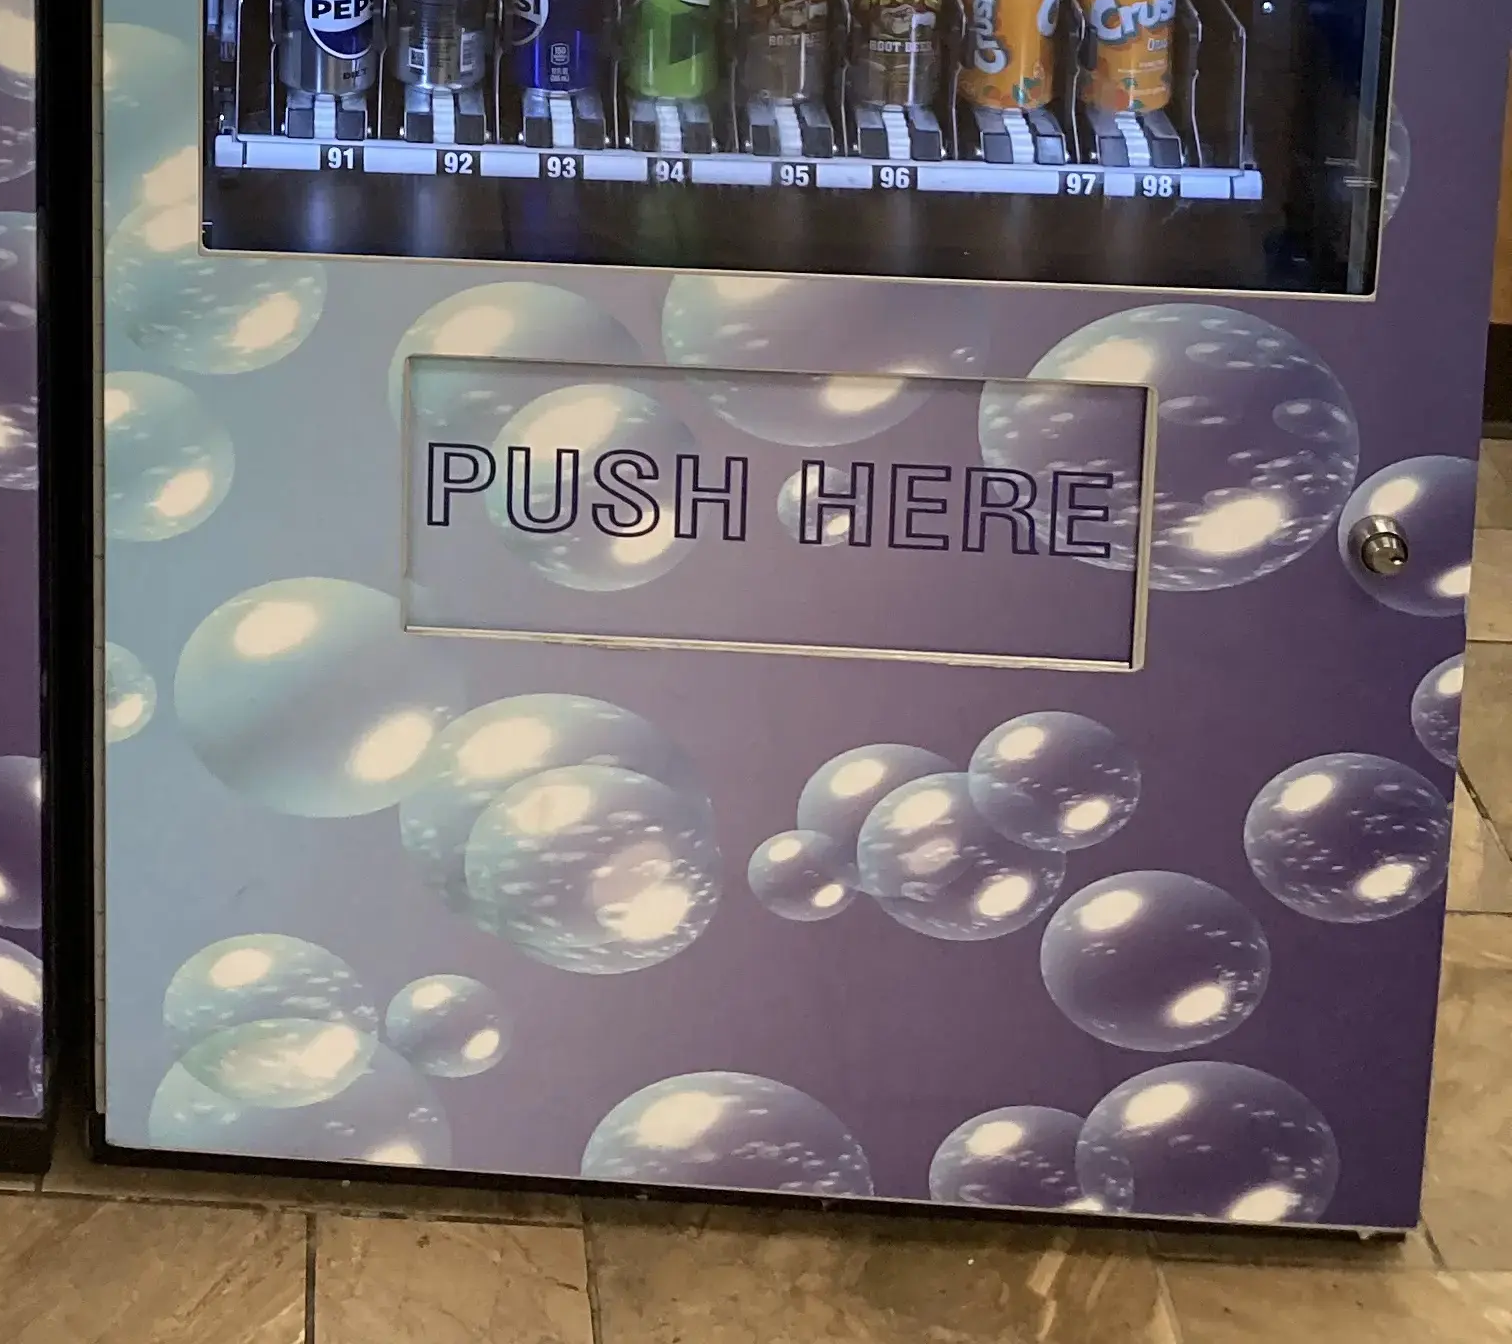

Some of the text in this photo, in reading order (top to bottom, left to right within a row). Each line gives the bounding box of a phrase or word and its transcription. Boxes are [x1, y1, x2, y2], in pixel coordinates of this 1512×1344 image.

[869, 39, 901, 53] ROOT
[328, 148, 355, 170] 91
[444, 152, 473, 175] 92
[547, 156, 576, 179] 93
[655, 160, 685, 184] 94
[780, 164, 809, 186] 95
[879, 166, 909, 189] 96
[1067, 173, 1096, 196] 97
[1142, 175, 1172, 198] 98
[426, 441, 1114, 559] PUSH HERE
